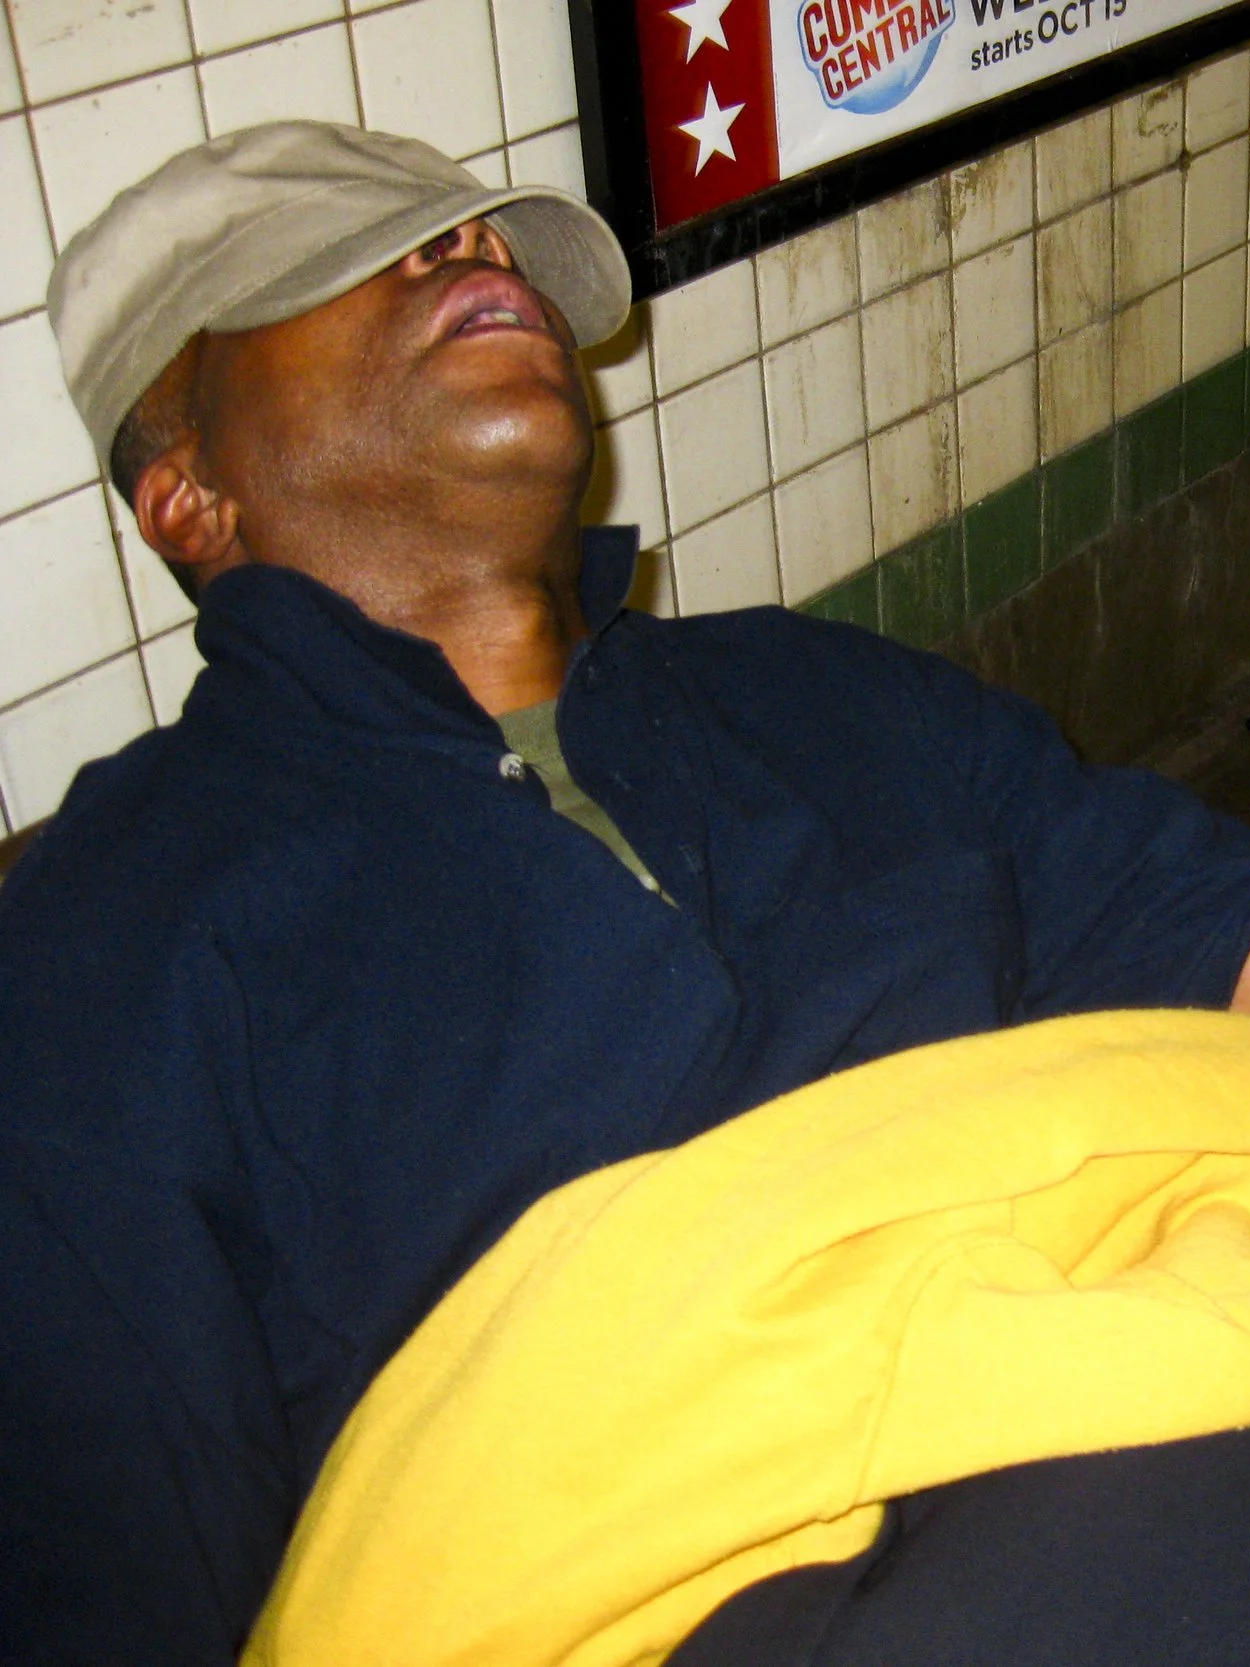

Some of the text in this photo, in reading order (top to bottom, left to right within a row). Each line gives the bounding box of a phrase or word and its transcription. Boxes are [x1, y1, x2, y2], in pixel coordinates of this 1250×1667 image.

[822, 0, 950, 100] CENTRAL
[971, 29, 1034, 71] starts
[1038, 0, 1095, 43] OCT
